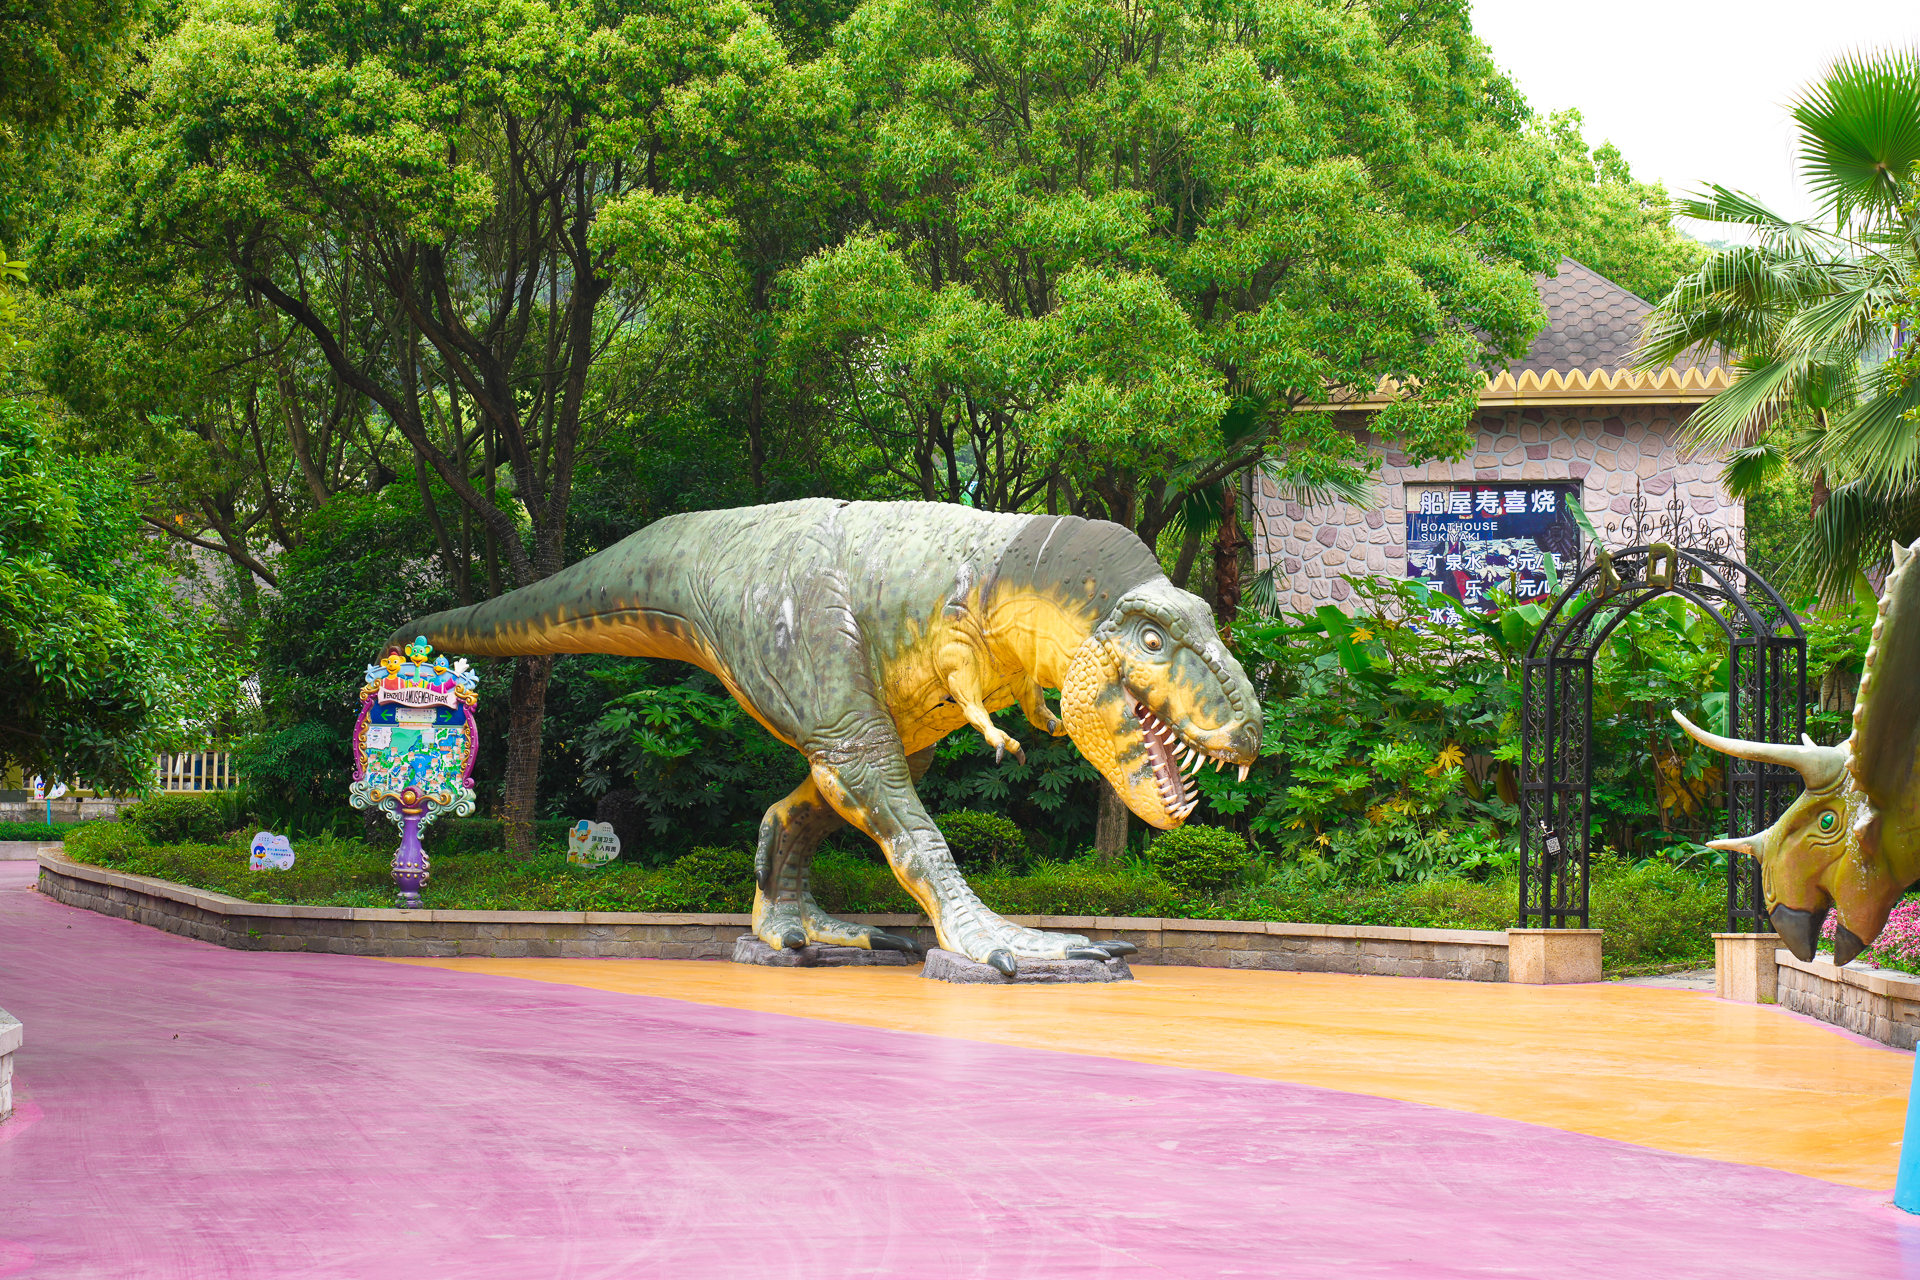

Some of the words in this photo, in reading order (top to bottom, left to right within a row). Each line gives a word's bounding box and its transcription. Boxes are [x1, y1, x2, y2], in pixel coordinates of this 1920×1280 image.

[1419, 489, 1556, 515] 船屋寿喜烧
[1420, 521, 1499, 532] BOATHOUSE
[1420, 532, 1480, 542] SUKIYAKI
[1426, 553, 1481, 571] 矿泉水
[1594, 542, 1677, 598] 入口
[405, 690, 434, 704] AMUSEMENT
[435, 695, 448, 704] PARK
